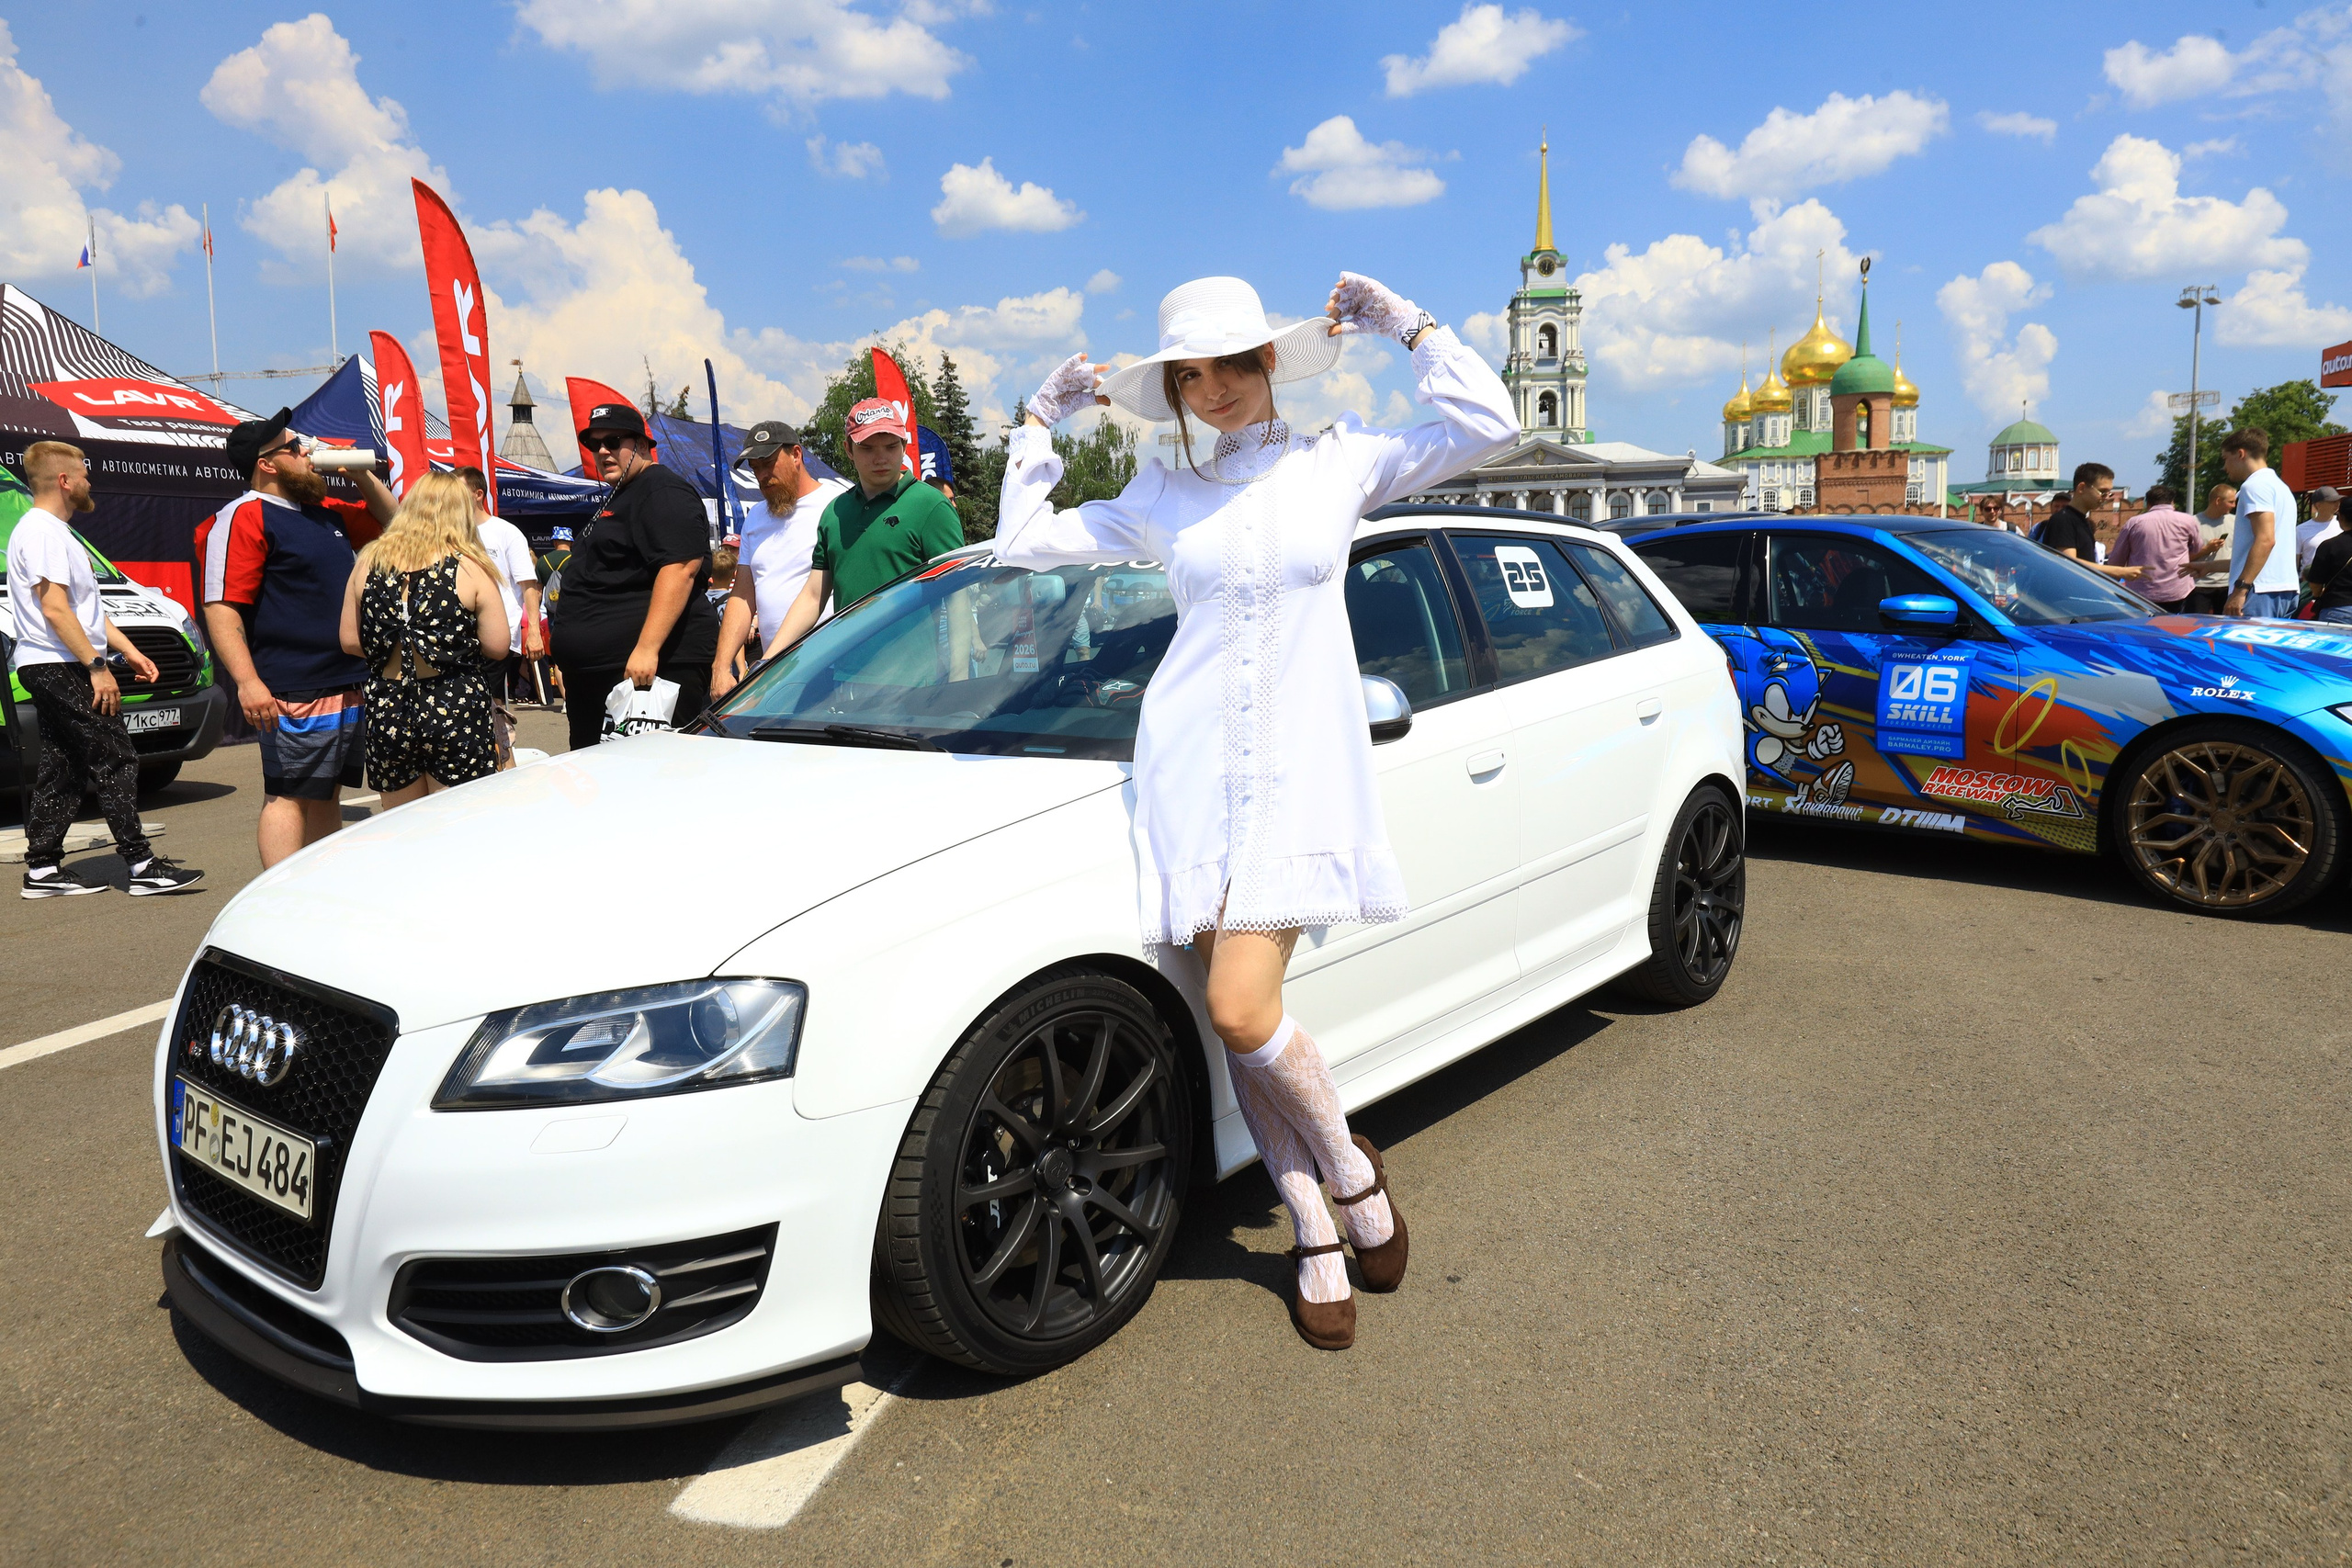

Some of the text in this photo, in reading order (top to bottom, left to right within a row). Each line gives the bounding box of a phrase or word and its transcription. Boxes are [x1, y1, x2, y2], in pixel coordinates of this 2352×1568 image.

[2323, 355, 2352, 375] auto.
[73, 389, 205, 412] LAVR
[117, 418, 164, 428] Твое
[856, 407, 891, 423] Orlando
[102, 459, 188, 478] АВТОКОСМЕТИКА
[195, 466, 245, 480] АВТОХ
[502, 488, 545, 501] АВТОХИМИЯ
[1503, 561, 1546, 592] 25
[1014, 644, 1035, 655] 2026
[1892, 652, 1966, 662] @WHEATEN_YORK
[1889, 664, 1960, 704] 06
[2189, 686, 2256, 701] ROLEX
[159, 708, 177, 721] 977
[1887, 741, 1951, 752] BARMALEY.PRO
[1928, 765, 2055, 797] MOSCOW
[1920, 782, 2007, 804] RACEWAY
[1018, 987, 1087, 1025] MICHELIN
[184, 1092, 309, 1207] PF EJ 484
